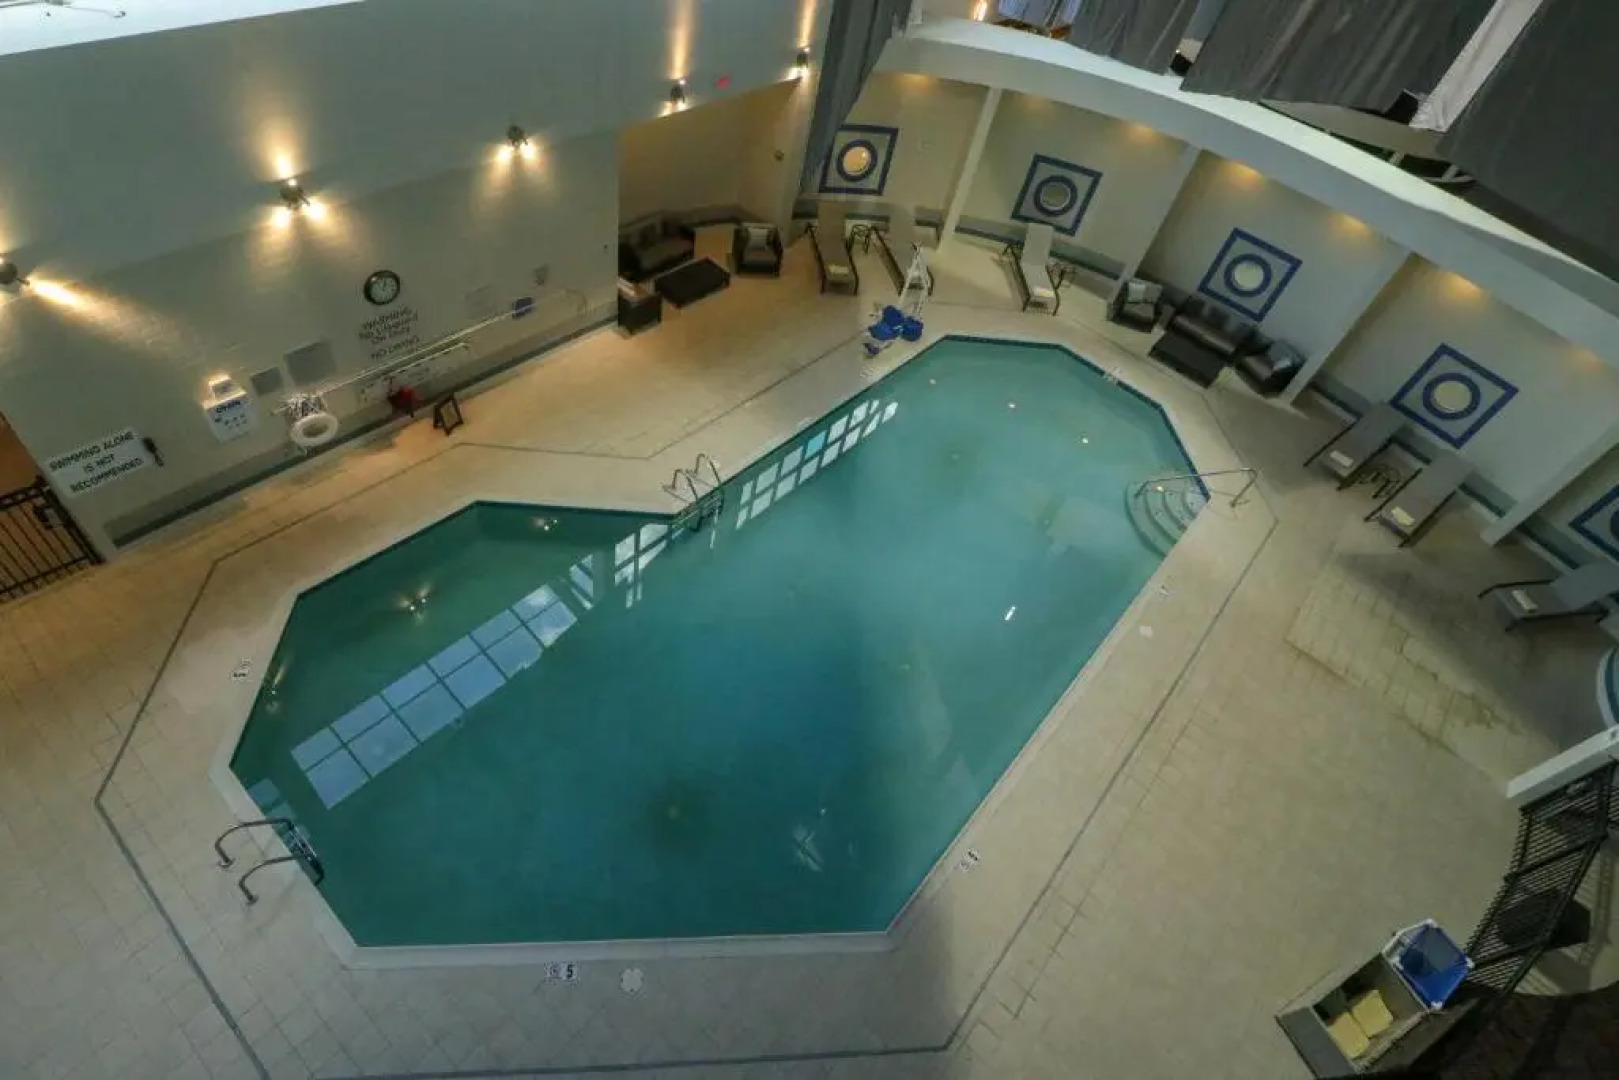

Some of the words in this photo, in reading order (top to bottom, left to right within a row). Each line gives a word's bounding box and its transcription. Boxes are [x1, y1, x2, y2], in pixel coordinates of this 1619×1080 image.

[49, 445, 101, 472] SWIMMING
[103, 431, 134, 450] ALONE
[83, 462, 95, 473] IS
[96, 453, 115, 467] NOT
[70, 457, 142, 493] RECOMMENDED
[566, 963, 574, 979] 5
